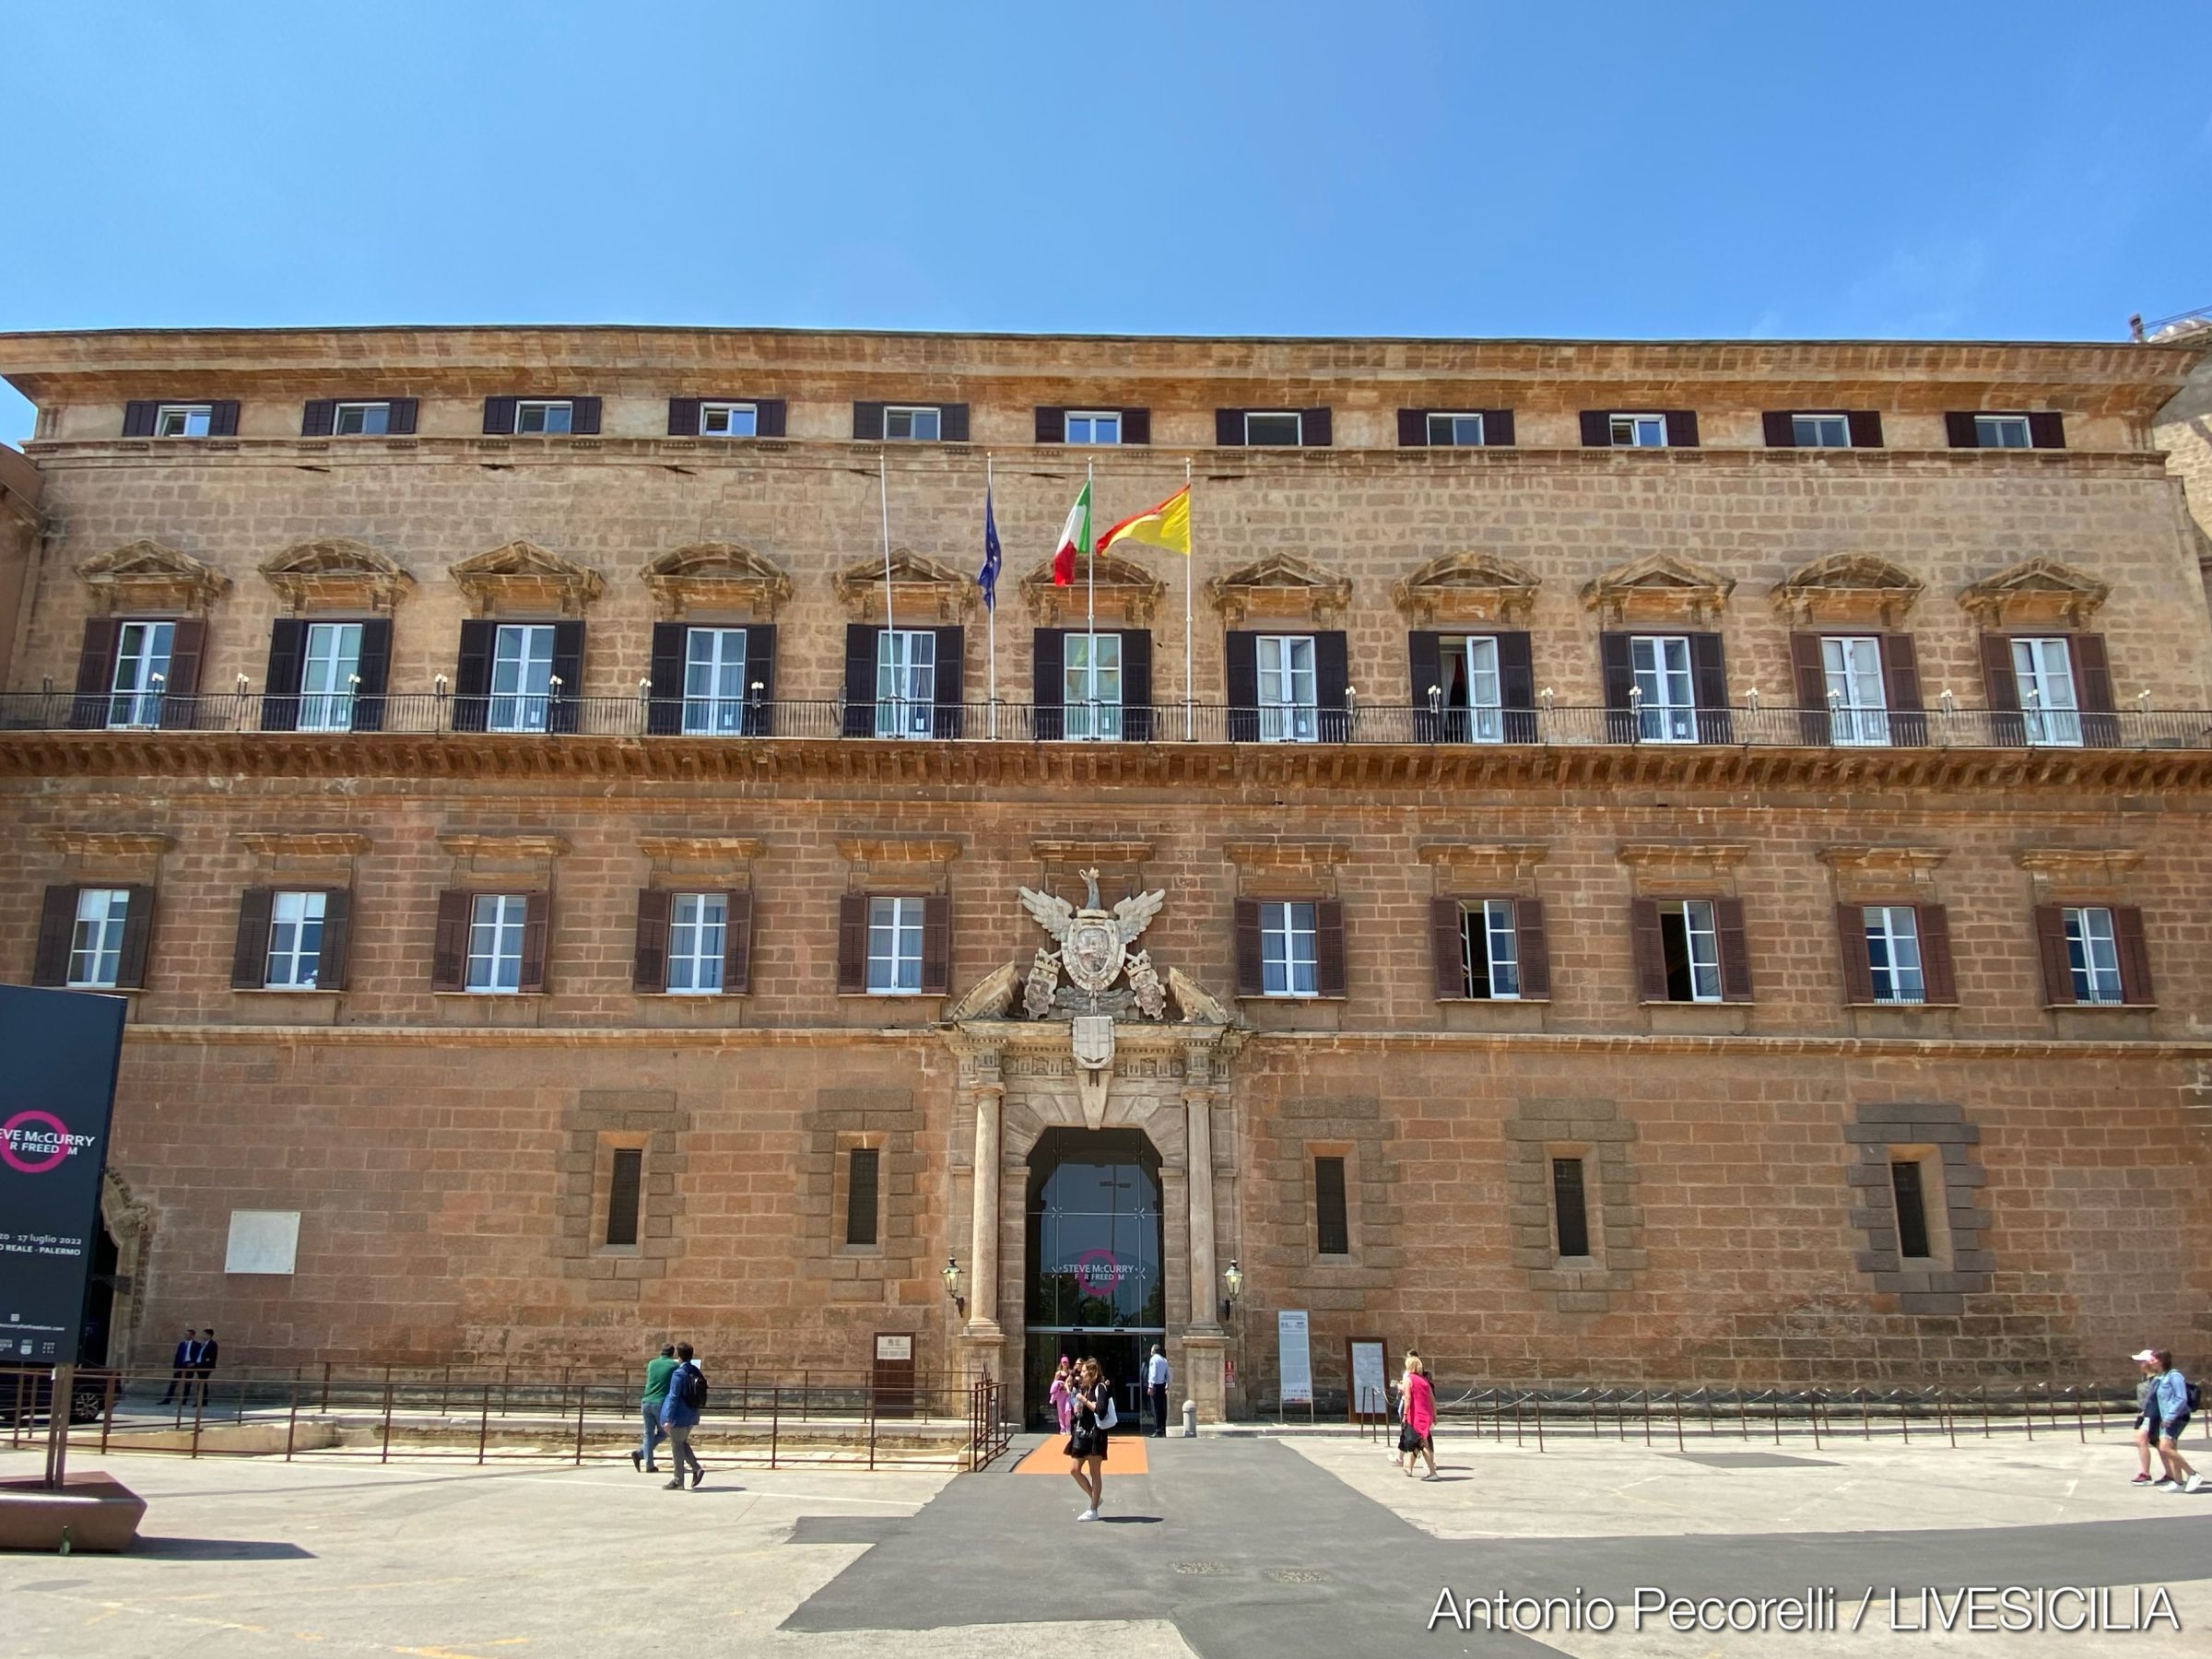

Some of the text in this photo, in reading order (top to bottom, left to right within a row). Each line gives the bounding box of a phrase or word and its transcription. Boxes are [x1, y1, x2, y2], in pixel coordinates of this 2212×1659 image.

[25, 1131, 96, 1147] McCURRY
[30, 1233, 57, 1244] luglio
[6, 1244, 33, 1253] REALE
[40, 1246, 81, 1255] PALERMO
[1063, 1265, 1134, 1273] STEVE McCURRY
